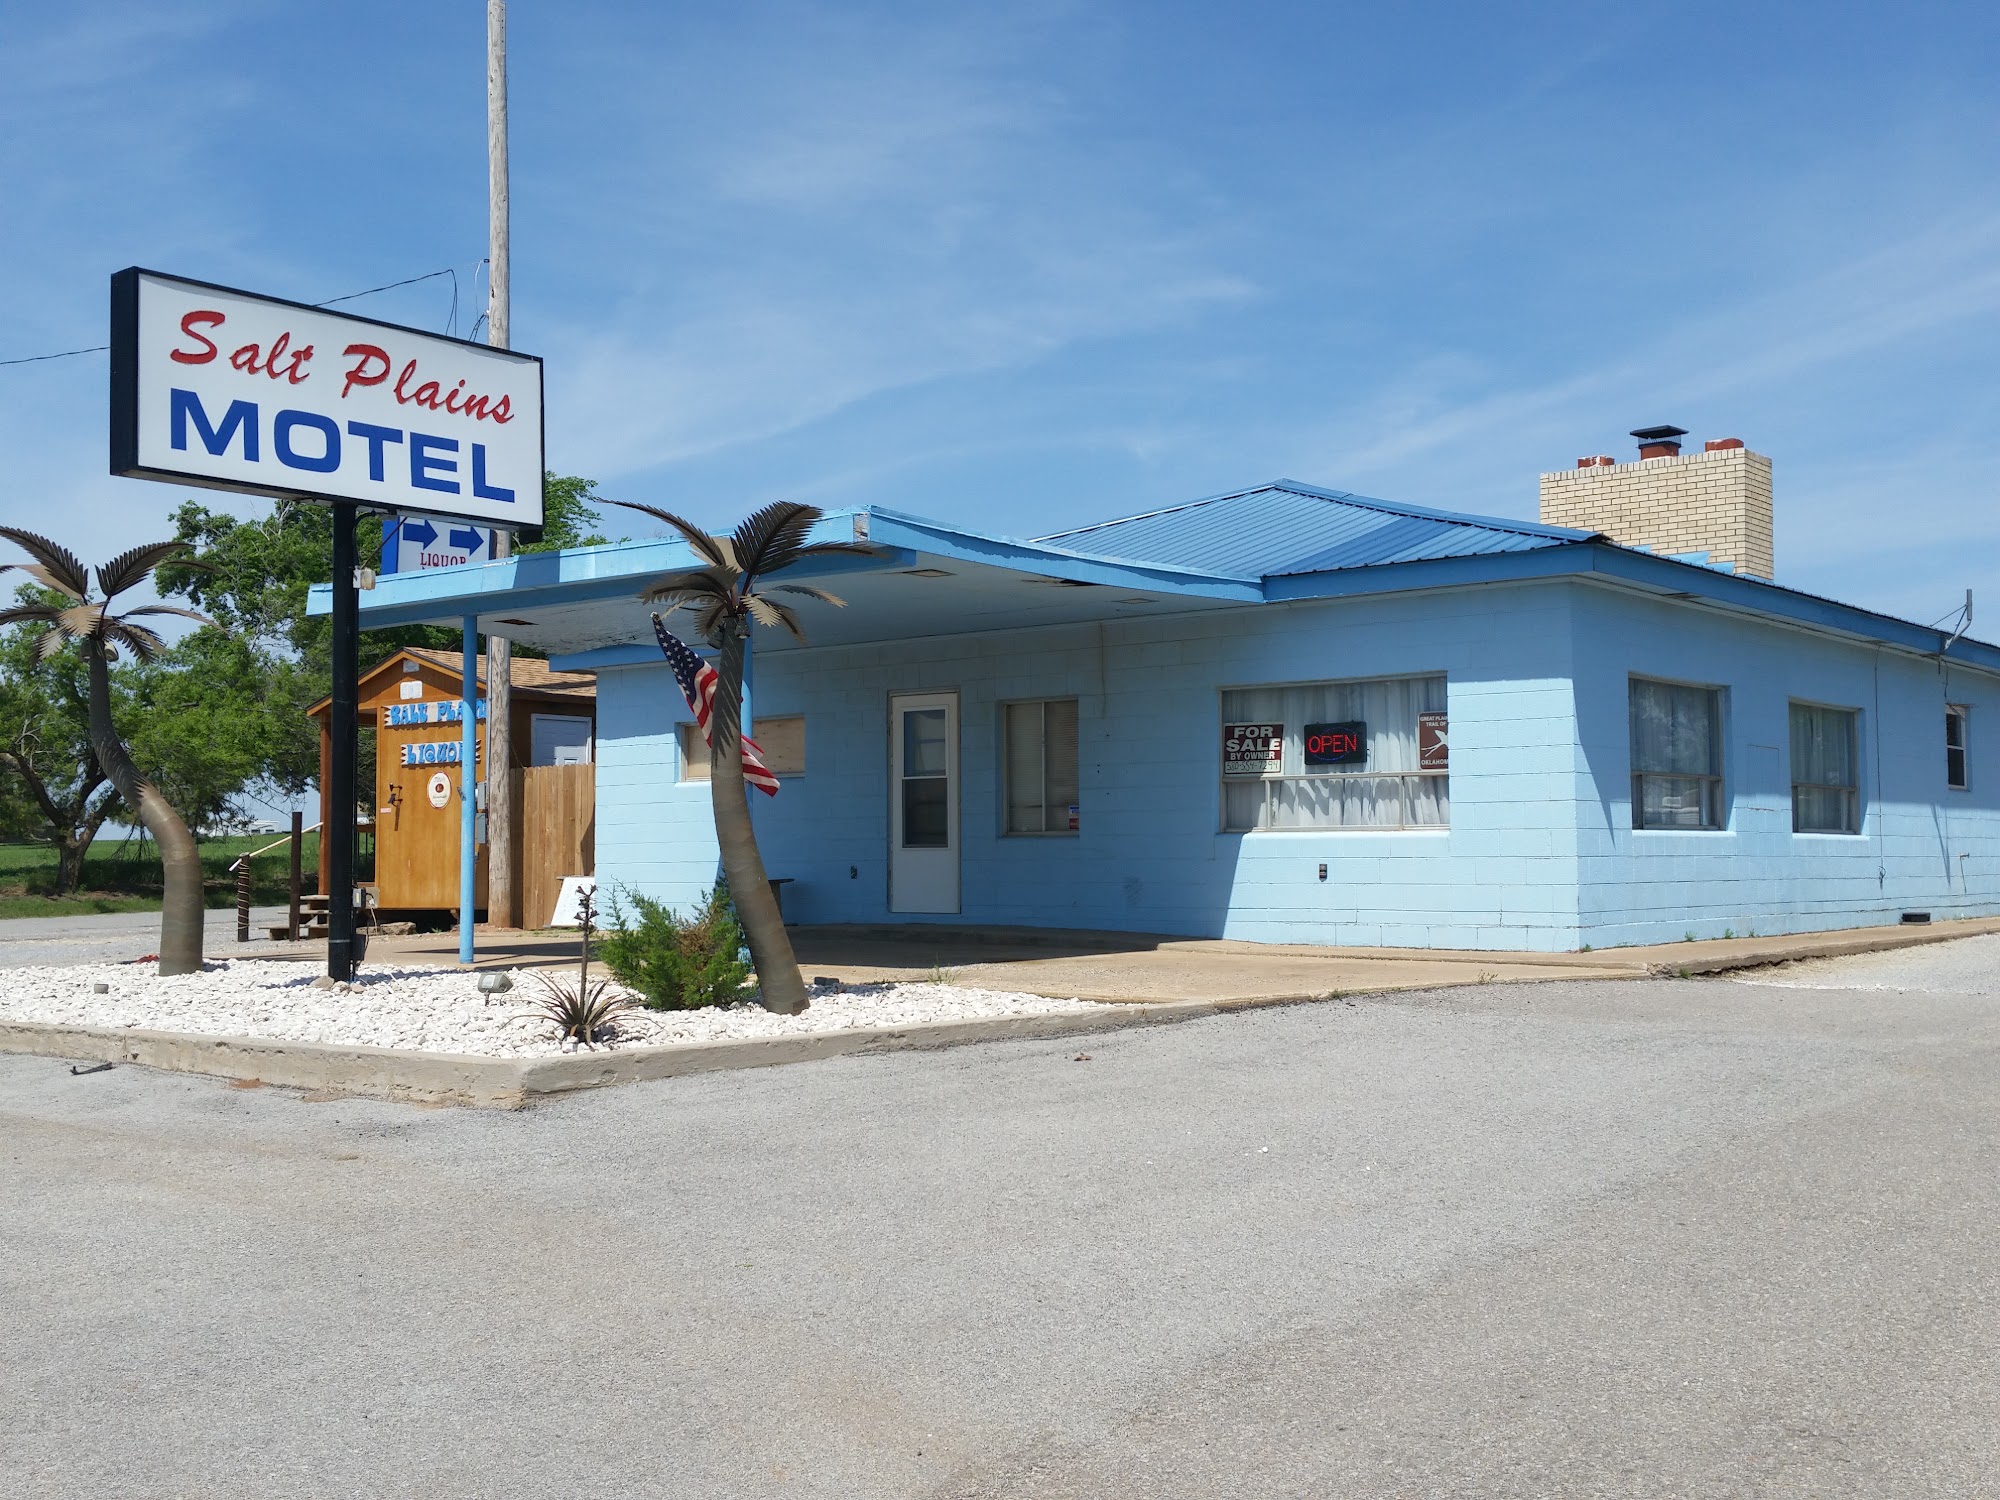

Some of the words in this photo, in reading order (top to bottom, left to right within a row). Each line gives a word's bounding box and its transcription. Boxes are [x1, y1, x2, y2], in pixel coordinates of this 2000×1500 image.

[170, 310, 314, 385] Salt
[341, 344, 515, 424] Plains
[170, 387, 516, 504] MOTEL
[390, 703, 428, 725] SALT
[1233, 726, 1274, 738] FOR
[1226, 738, 1281, 752] SALE
[1307, 734, 1357, 754] OPEN
[1230, 752, 1242, 760] BY
[1244, 751, 1275, 760] OWNER
